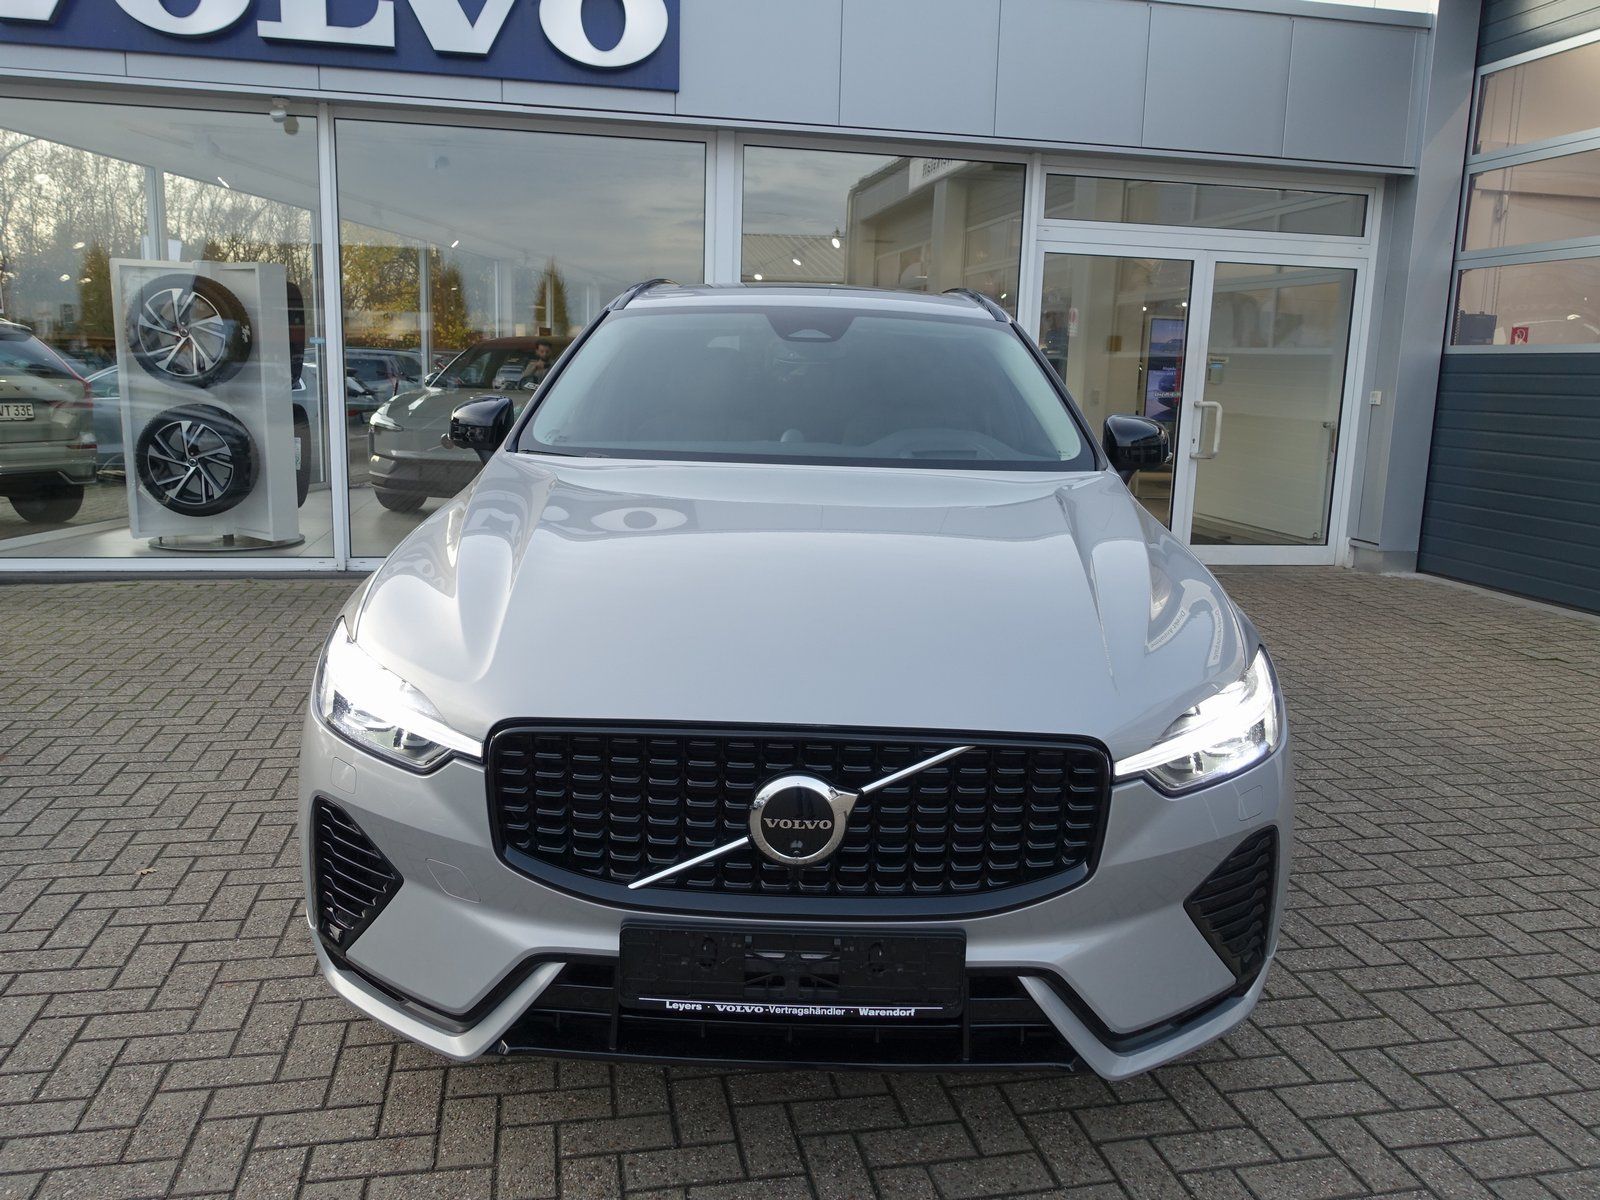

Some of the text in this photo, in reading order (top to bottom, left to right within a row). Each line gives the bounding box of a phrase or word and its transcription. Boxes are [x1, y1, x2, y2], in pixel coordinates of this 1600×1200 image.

[0, 0, 668, 68] LVO
[13, 405, 33, 417] 33E
[763, 818, 832, 830] VOLVO
[665, 1000, 702, 1011] Leyers
[858, 1008, 916, 1017] Warendorf
